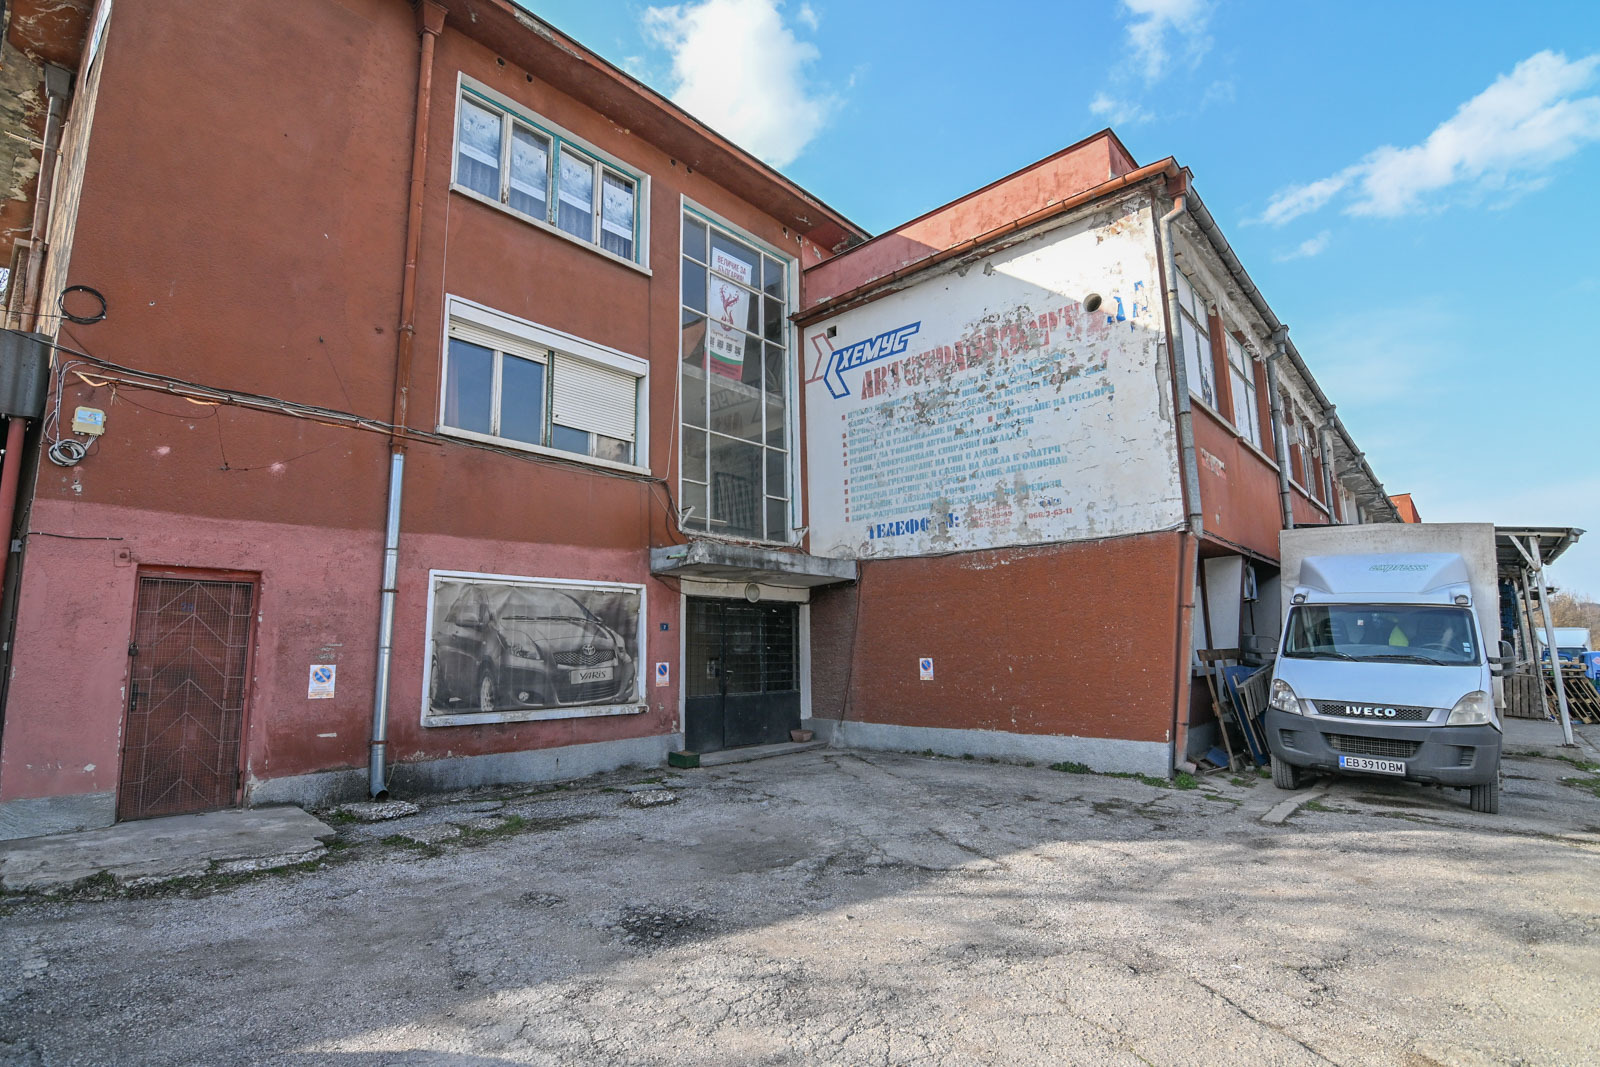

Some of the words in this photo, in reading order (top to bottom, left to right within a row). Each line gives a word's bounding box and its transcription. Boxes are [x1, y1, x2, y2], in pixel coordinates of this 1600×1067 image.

[717, 255, 740, 273] ВЕЛИЧИЕ
[838, 325, 918, 370] ХЕМУС
[934, 457, 945, 466] НА
[1369, 564, 1428, 573] express
[1345, 705, 1397, 717] IVECO
[1346, 758, 1360, 768] EB
[1361, 760, 1387, 771] 3910
[1388, 763, 1404, 773] BM
